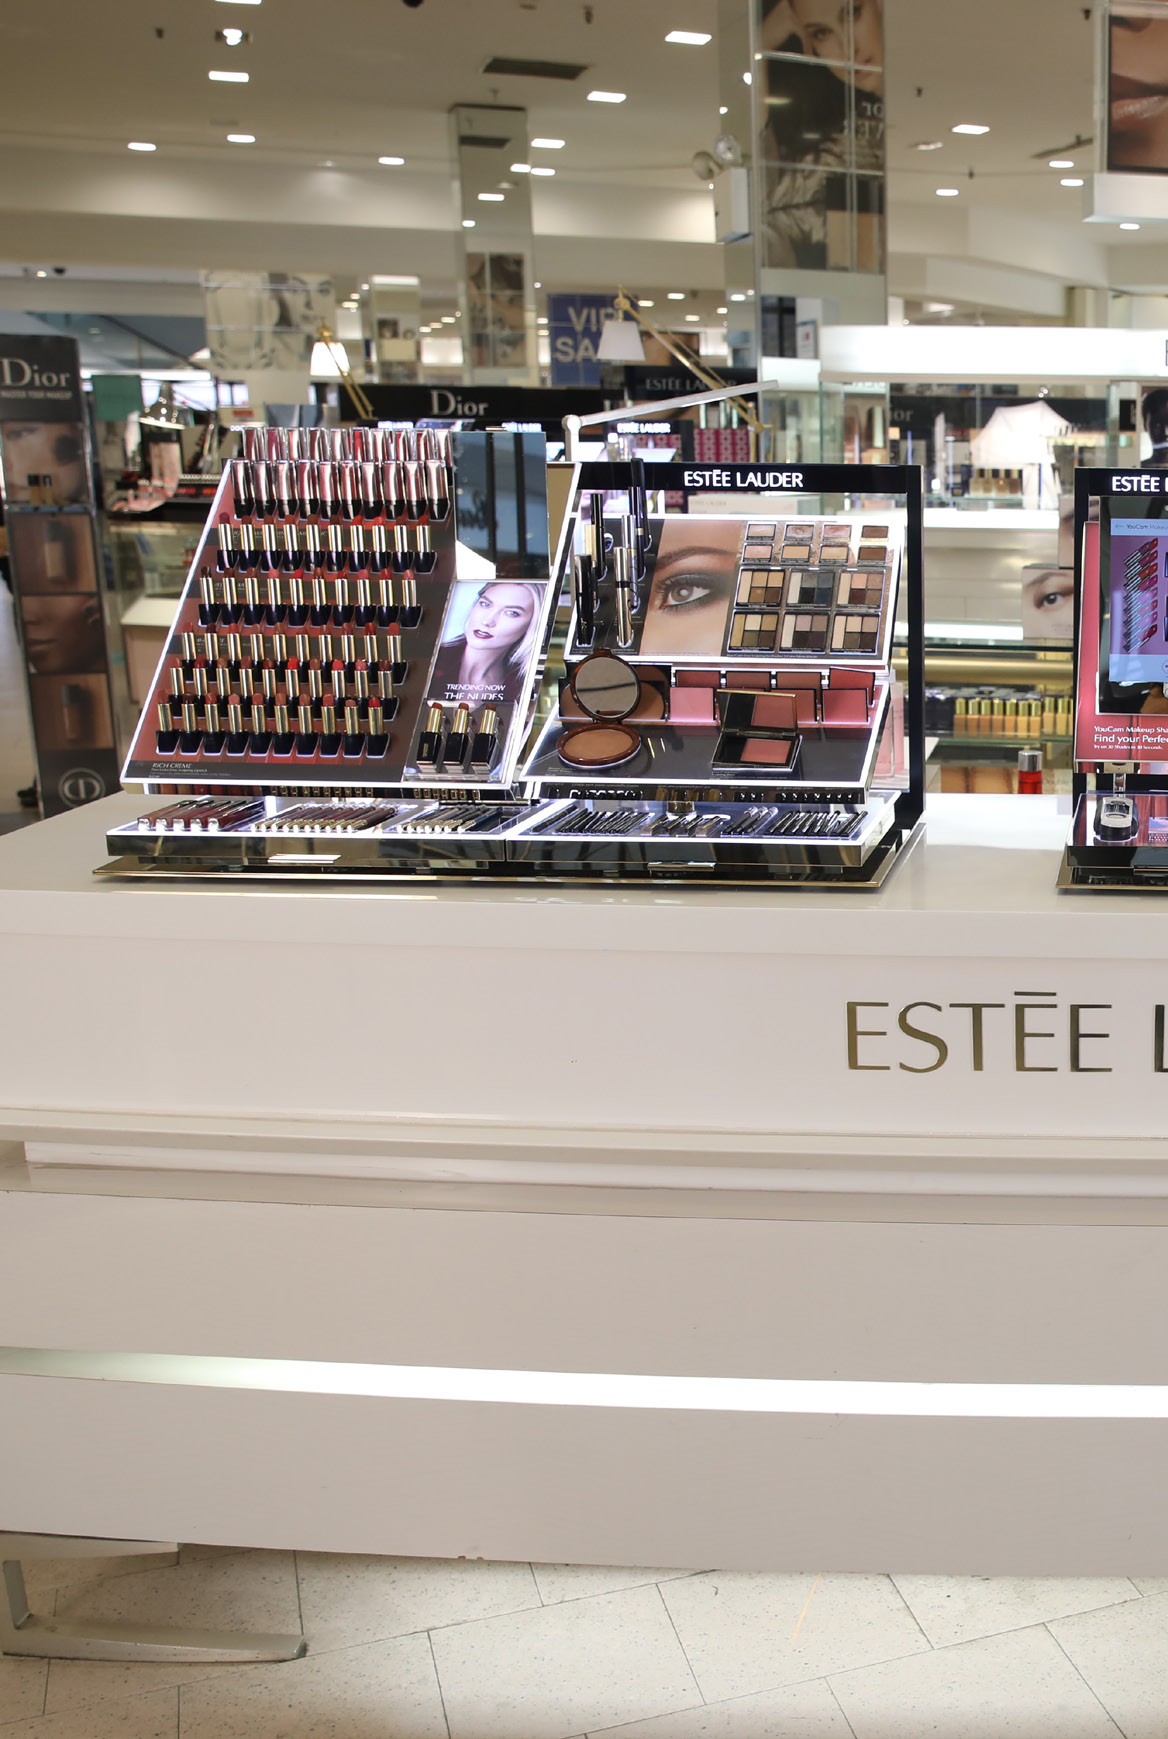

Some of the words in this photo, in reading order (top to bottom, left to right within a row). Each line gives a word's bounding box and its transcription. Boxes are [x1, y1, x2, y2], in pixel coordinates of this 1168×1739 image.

[567, 305, 618, 333] VIP
[0, 357, 72, 387] Dior
[430, 390, 489, 417] Dior
[736, 471, 804, 489] LAUDER
[444, 691, 466, 700] THE
[446, 683, 485, 691] TRENDING
[485, 684, 507, 692] NOW
[1093, 725, 1125, 733] YouCam
[1125, 726, 1155, 735] Makeup
[1093, 733, 1115, 743] Find
[1116, 736, 1140, 745] your
[845, 989, 1113, 1074] ESTĒE
